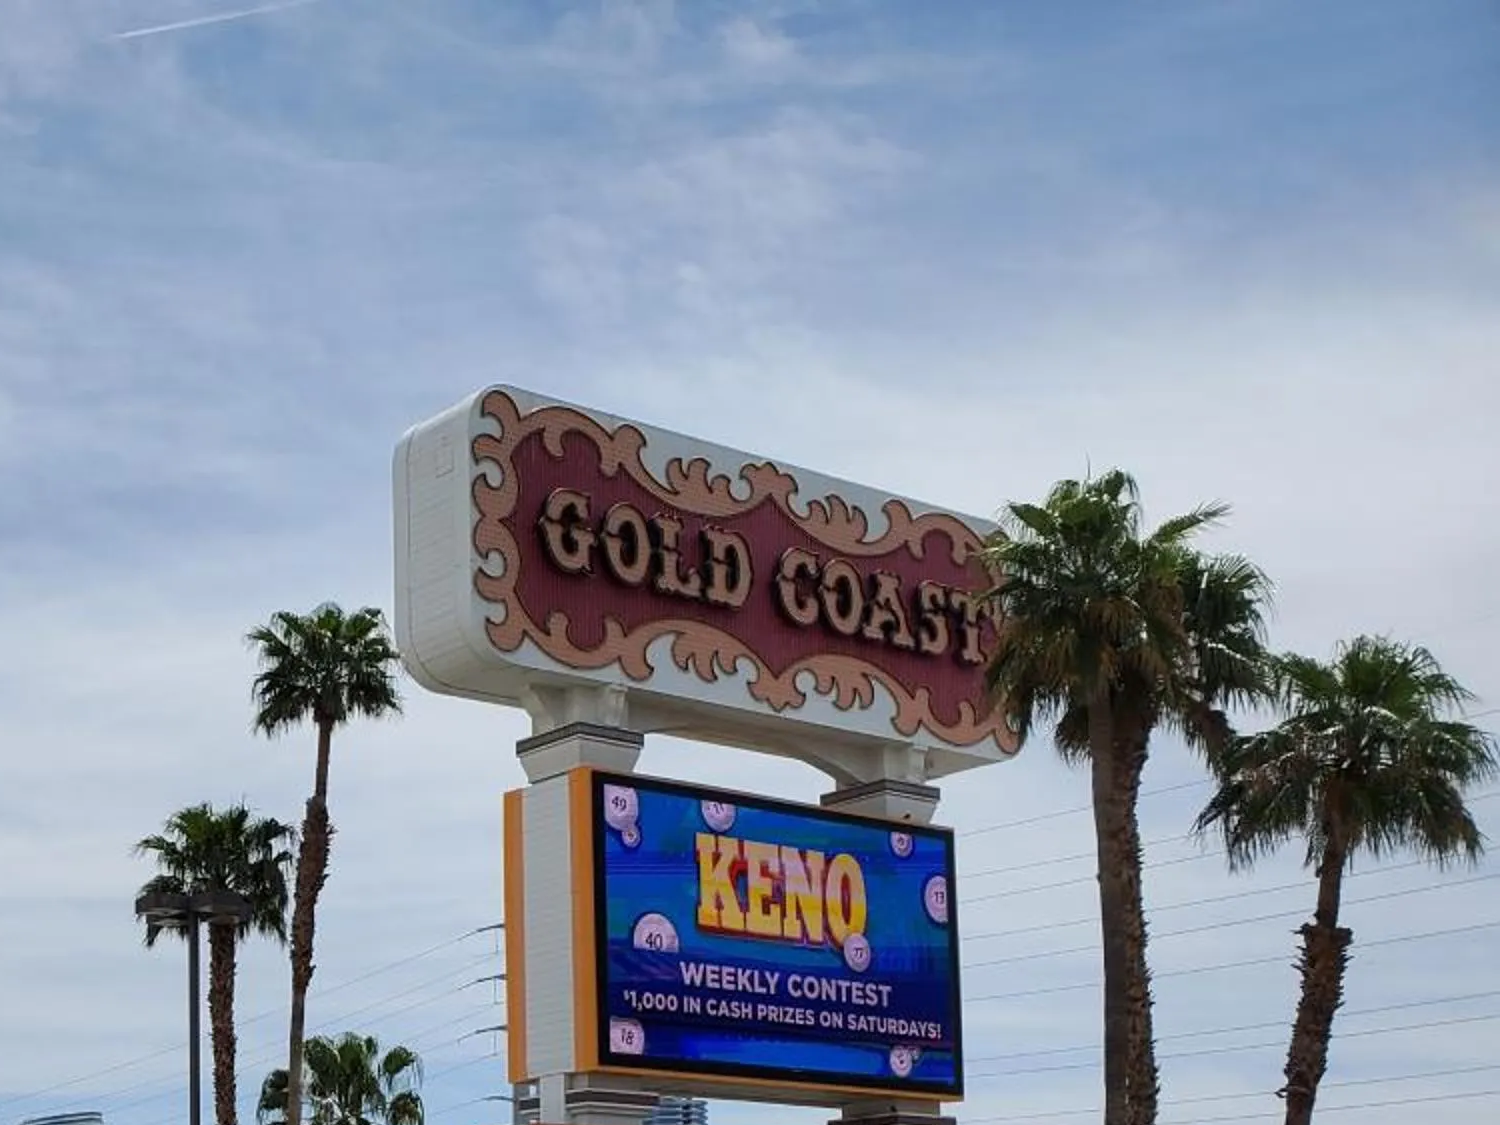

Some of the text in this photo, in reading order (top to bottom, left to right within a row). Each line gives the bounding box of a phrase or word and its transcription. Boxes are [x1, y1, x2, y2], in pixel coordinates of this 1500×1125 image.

[538, 486, 992, 662] GOLD COAST
[694, 832, 867, 950] KENO
[623, 989, 941, 1039] $1,000 IN CASH PRIZES ON SATURDAYS!
[679, 961, 892, 1008] WEEKLY CONTEST
